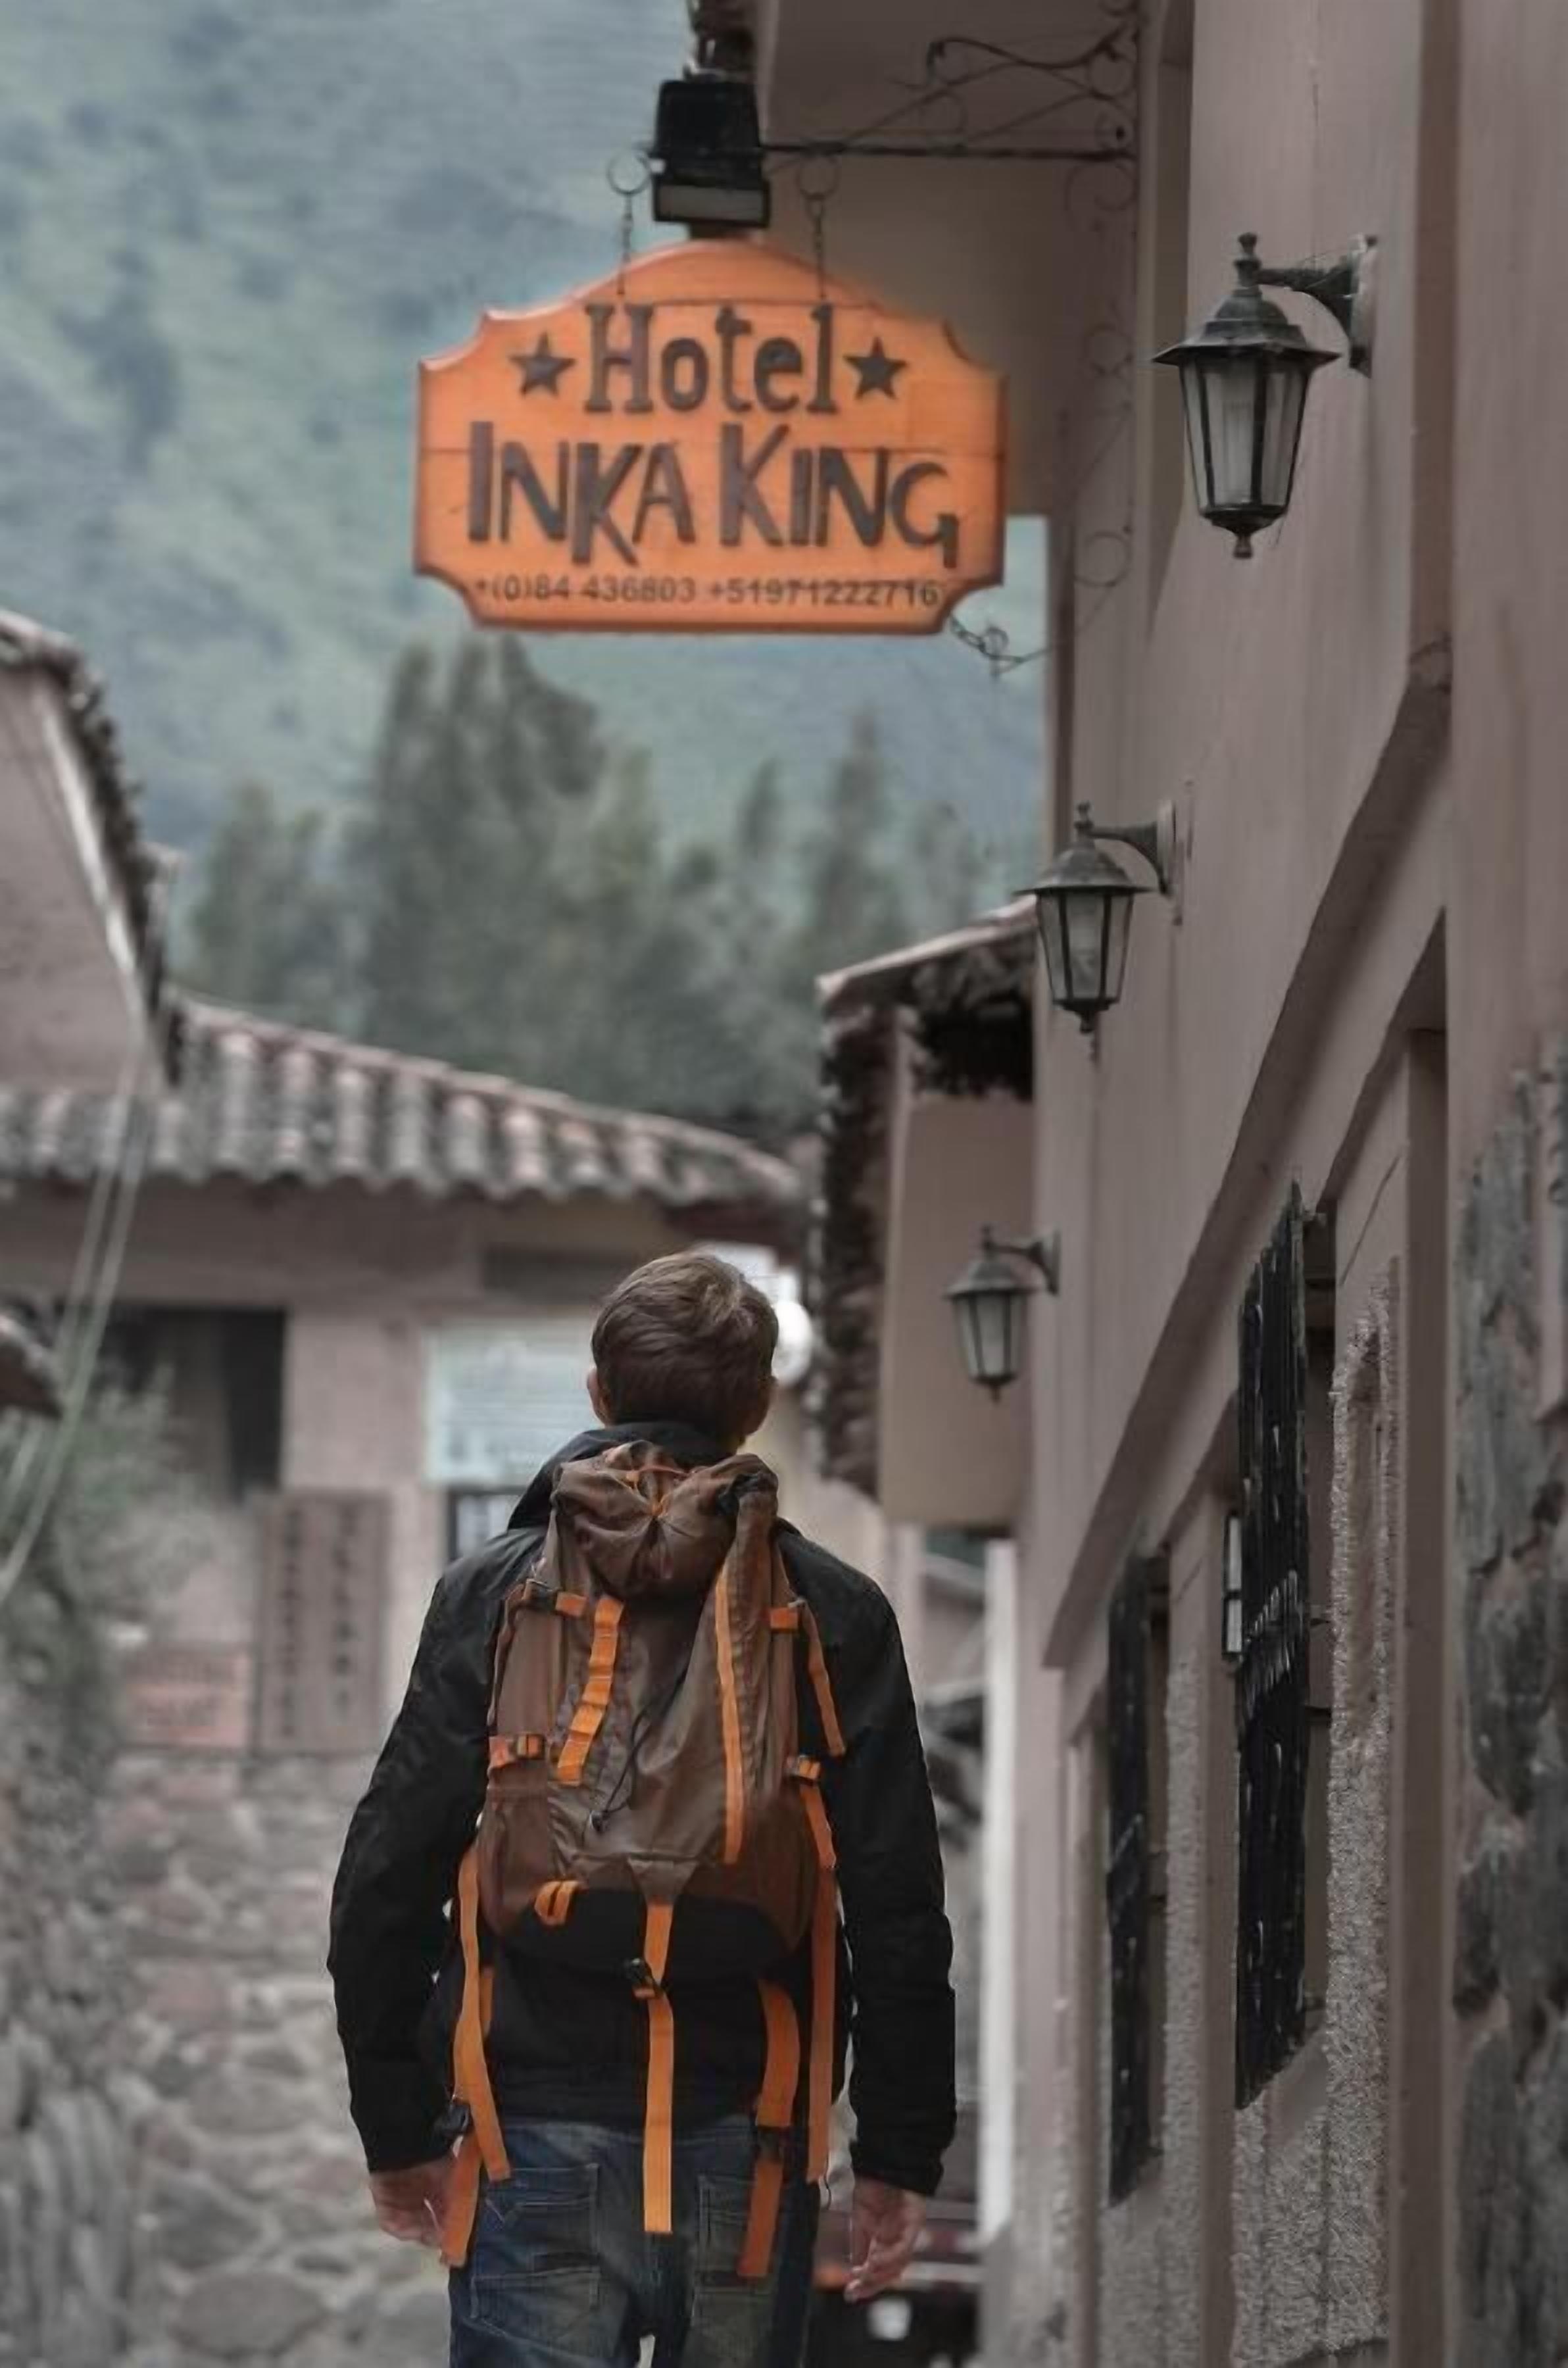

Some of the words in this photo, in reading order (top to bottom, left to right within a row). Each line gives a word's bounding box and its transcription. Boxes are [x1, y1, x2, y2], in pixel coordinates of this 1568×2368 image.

[583, 303, 838, 414] Hotel
[467, 421, 697, 567] INKA
[719, 424, 959, 570] KING
[581, 575, 697, 604] 436803
